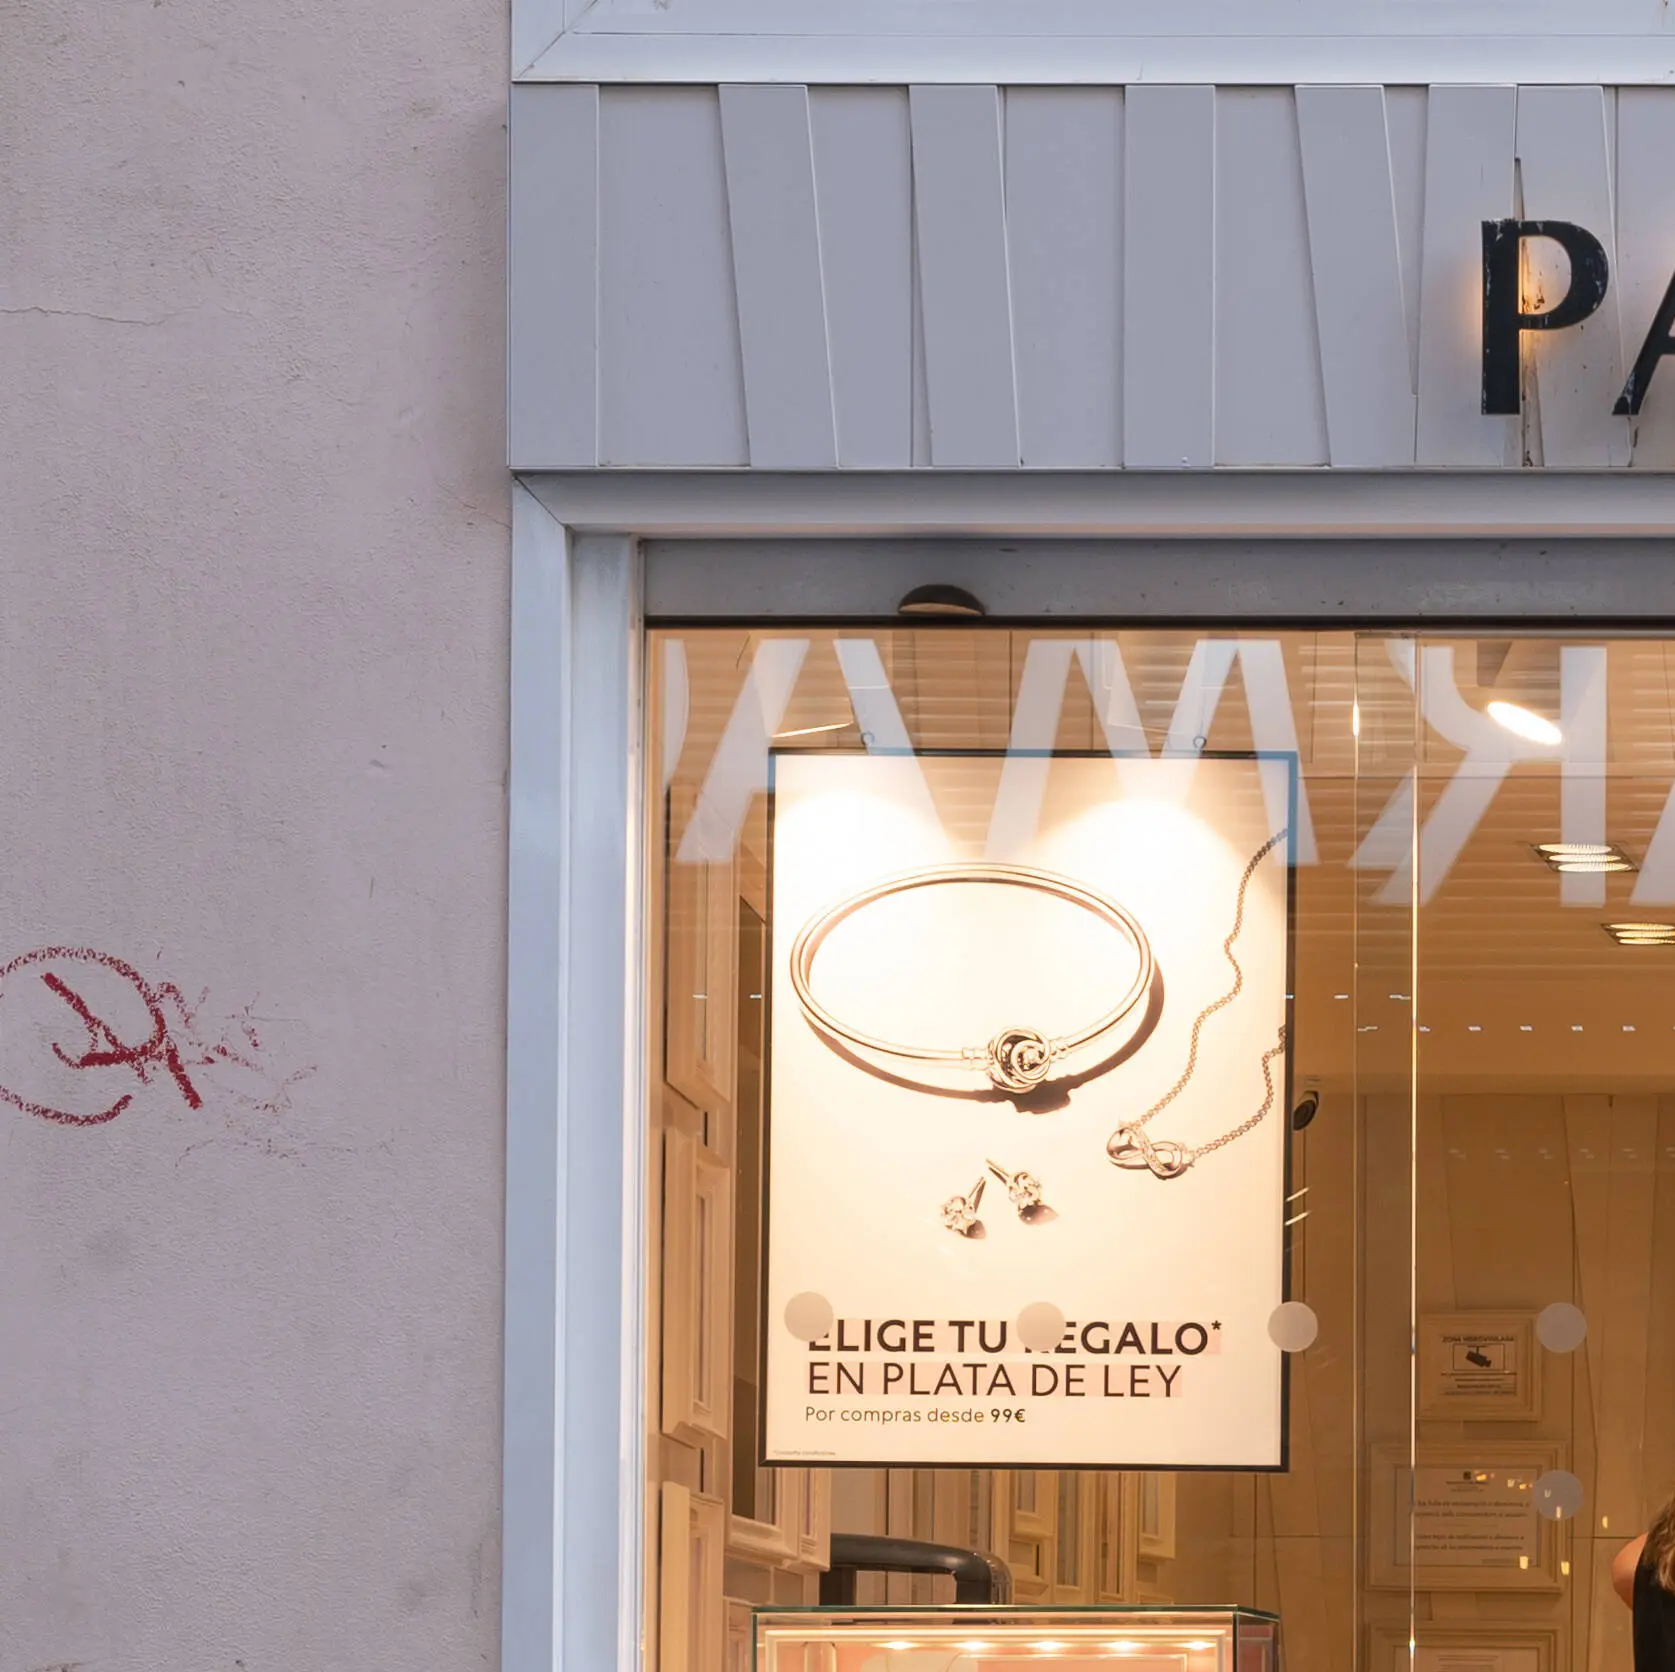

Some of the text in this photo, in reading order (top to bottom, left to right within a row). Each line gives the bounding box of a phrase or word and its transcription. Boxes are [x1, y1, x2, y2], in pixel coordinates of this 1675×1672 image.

[949, 1320, 1007, 1353] TU
[1025, 1320, 1222, 1355] EGALO
[808, 1362, 1182, 1398] EN PLATA DE LEY
[805, 1406, 1026, 1427] Por compras desde 99€
